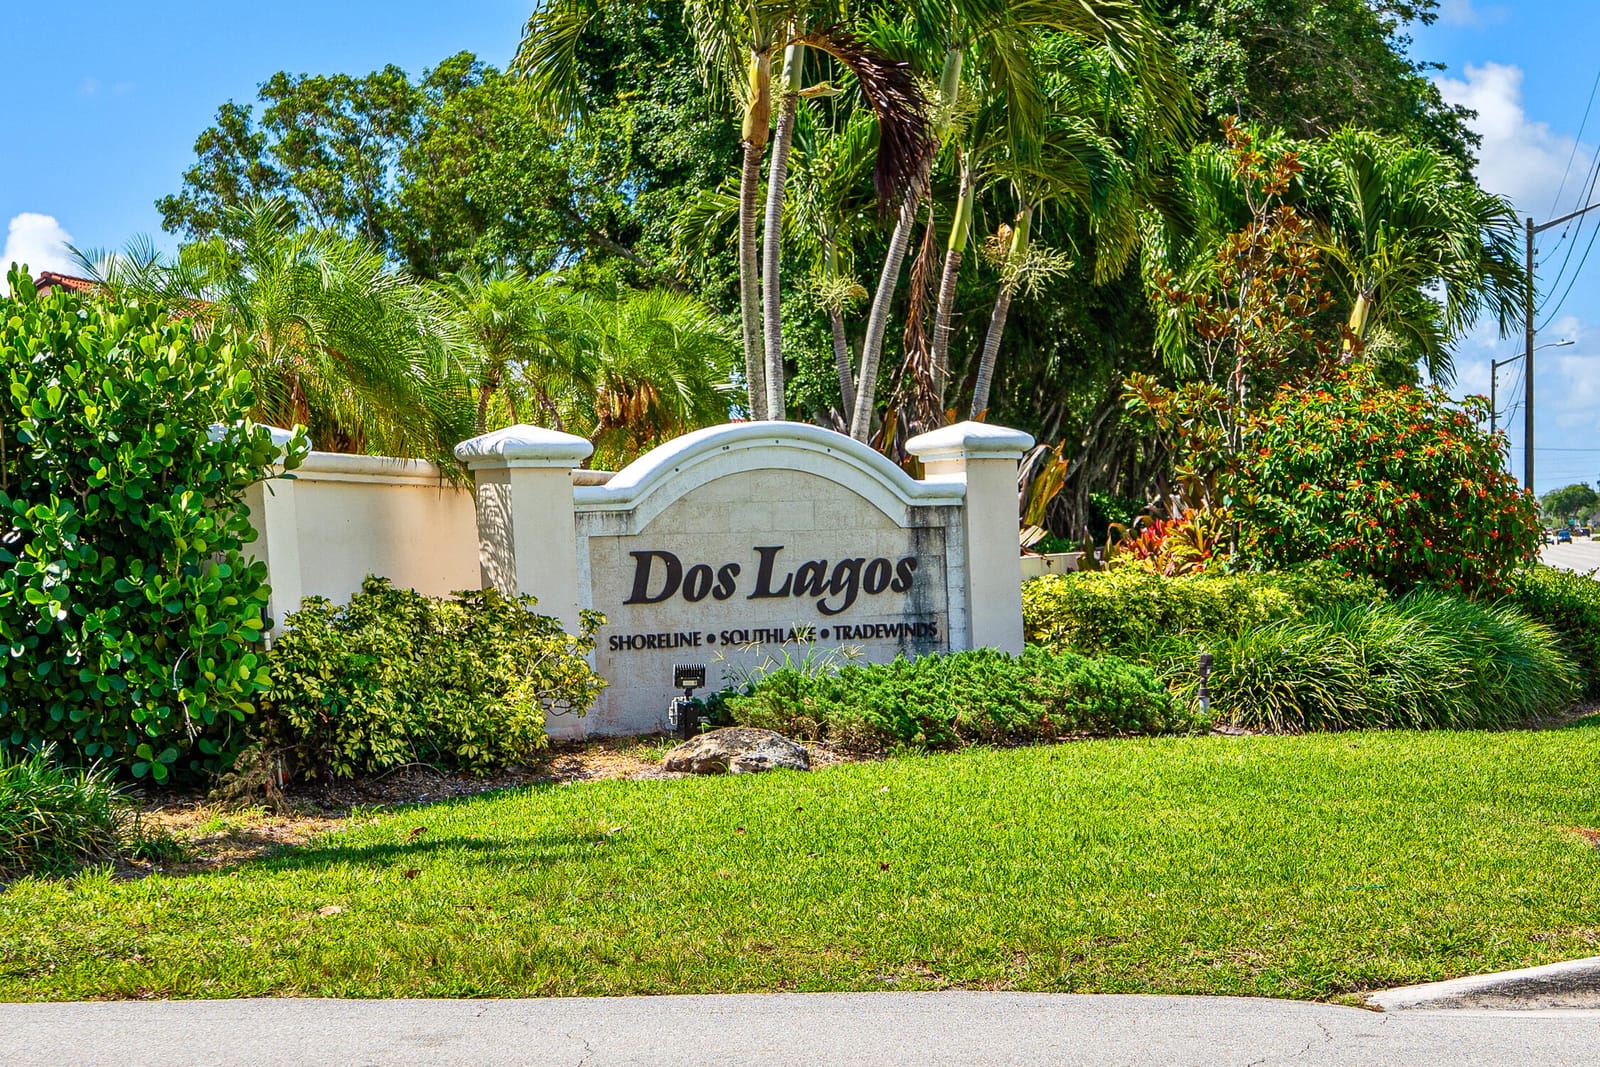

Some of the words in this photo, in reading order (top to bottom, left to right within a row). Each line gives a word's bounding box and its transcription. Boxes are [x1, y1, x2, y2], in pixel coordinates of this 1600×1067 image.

[623, 550, 741, 605] Dos
[746, 545, 917, 616] Lagos
[609, 631, 702, 651] SHORELINE
[832, 622, 937, 641] TRADEWINDS
